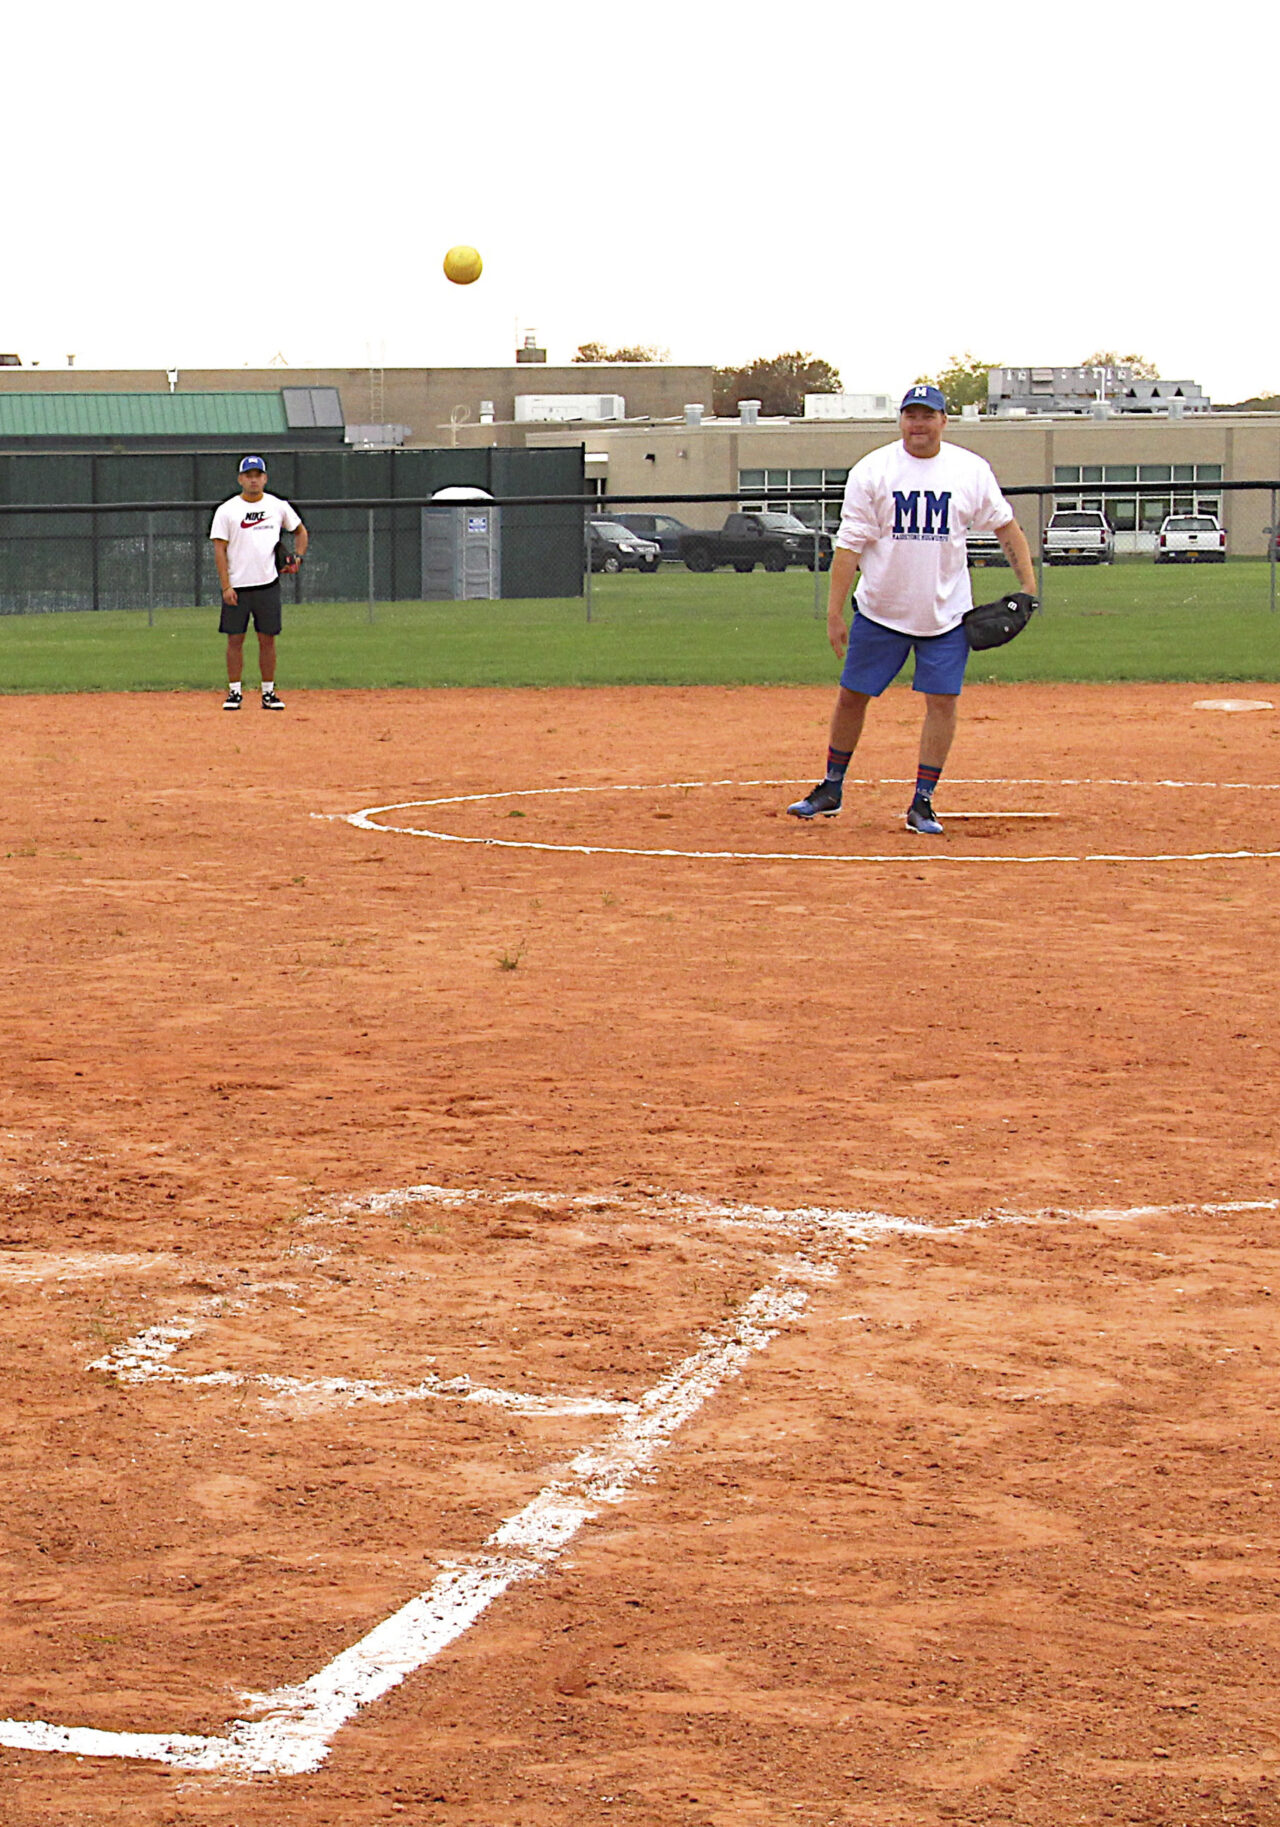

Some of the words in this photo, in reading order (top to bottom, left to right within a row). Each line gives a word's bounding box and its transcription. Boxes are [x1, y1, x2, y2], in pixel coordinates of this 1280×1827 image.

[913, 387, 927, 397] M
[245, 510, 266, 521] NIKE
[892, 490, 952, 534] MM
